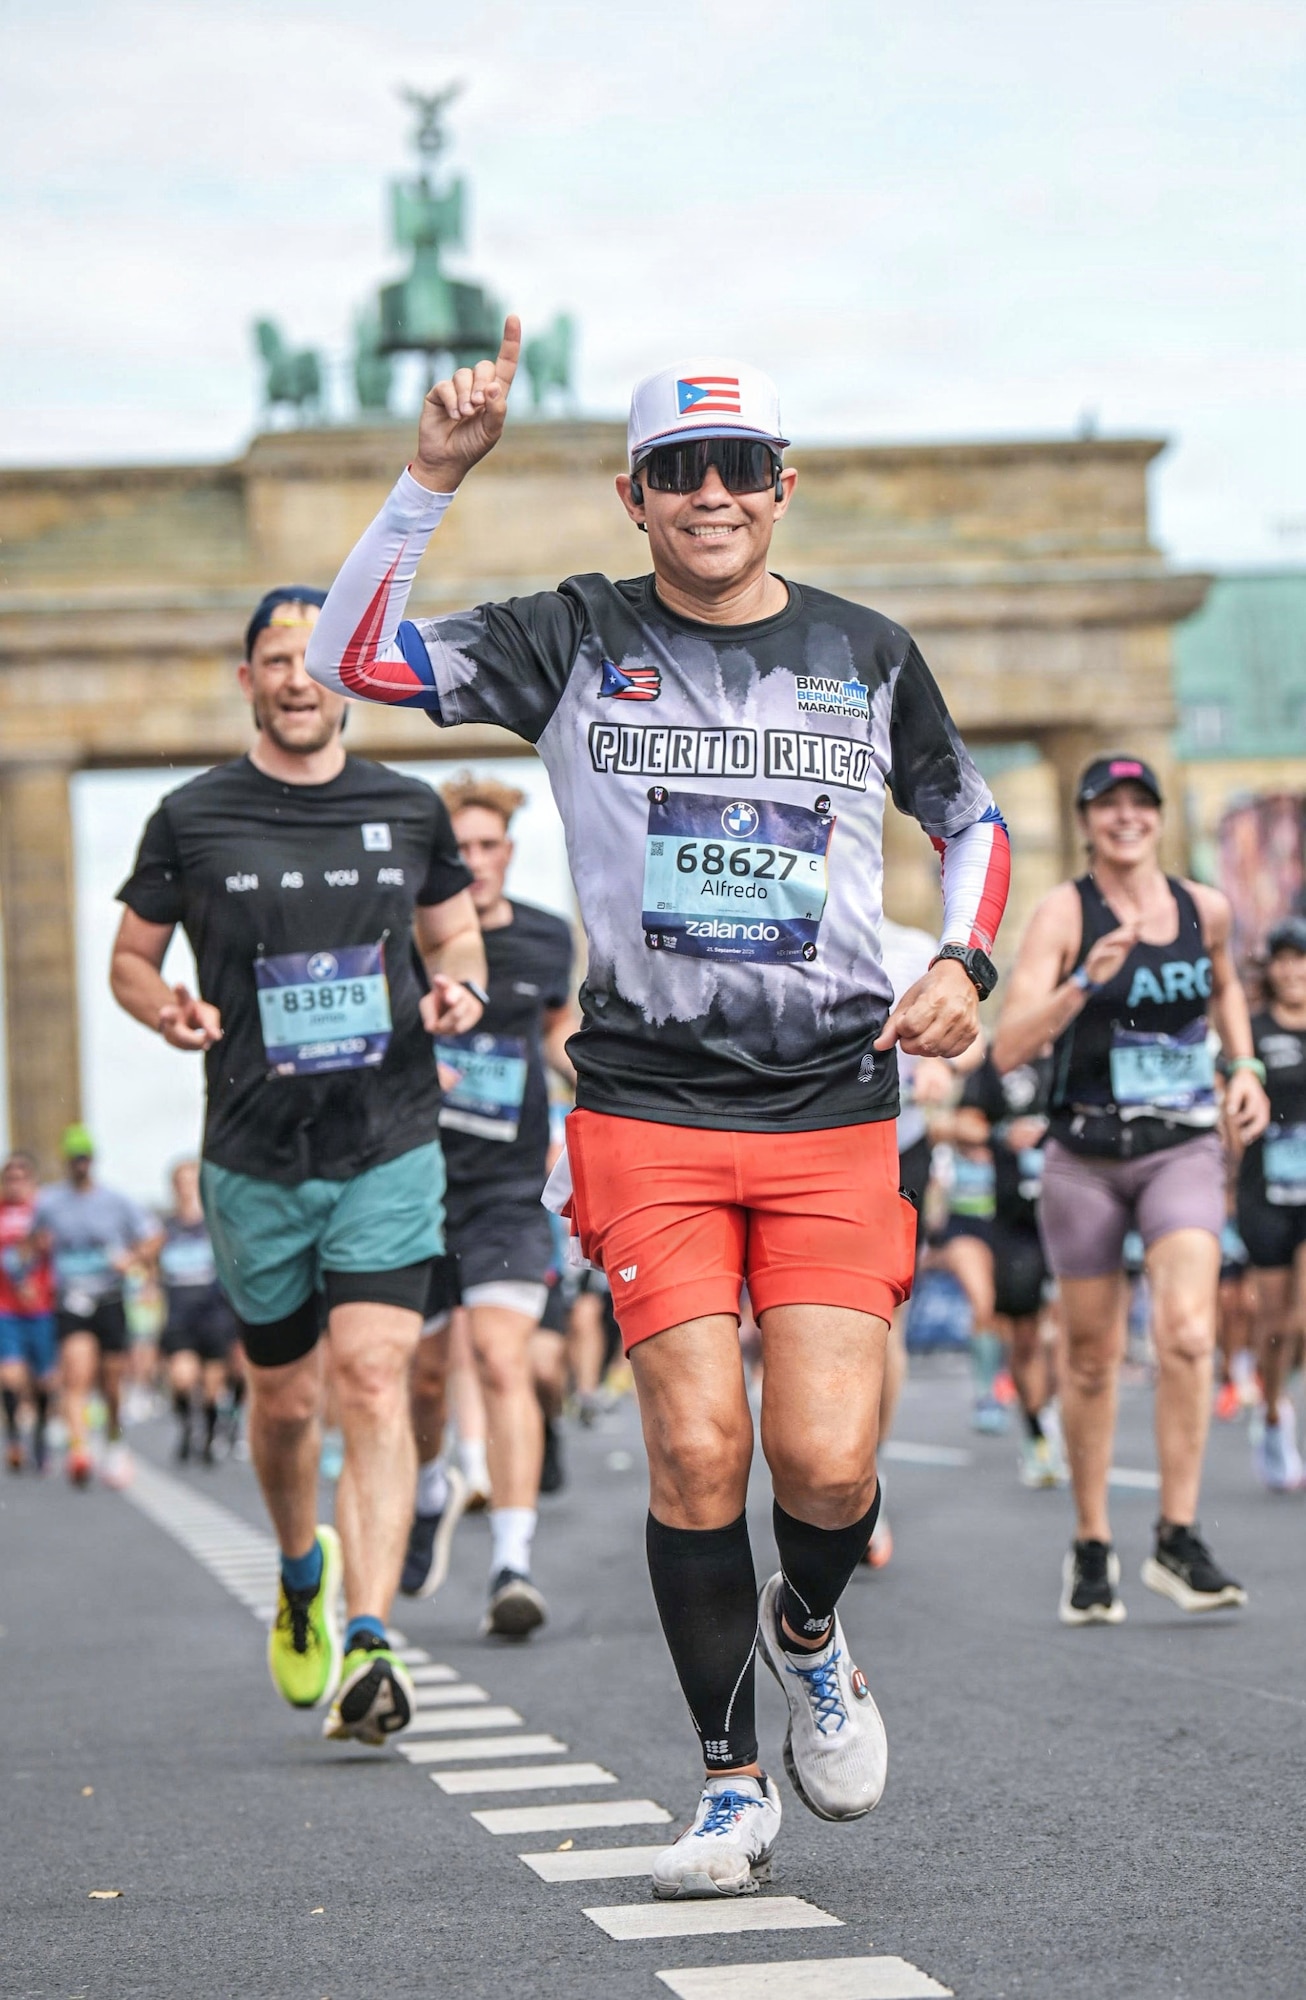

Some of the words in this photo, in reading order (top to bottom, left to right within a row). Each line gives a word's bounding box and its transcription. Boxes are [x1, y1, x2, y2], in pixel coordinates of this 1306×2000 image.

[796, 677, 840, 693] BMW
[797, 691, 842, 705] BERLIN
[798, 702, 868, 720] MARATHON
[591, 724, 754, 776] PUERTO
[767, 731, 873, 789] RICO
[676, 842, 798, 881] 68627
[809, 860, 818, 872] C
[281, 871, 304, 889] AS
[324, 869, 360, 887] YOU
[700, 879, 768, 900] Alfredo
[684, 919, 780, 942] zalando
[714, 946, 742, 955] September
[282, 983, 367, 1014] 83878
